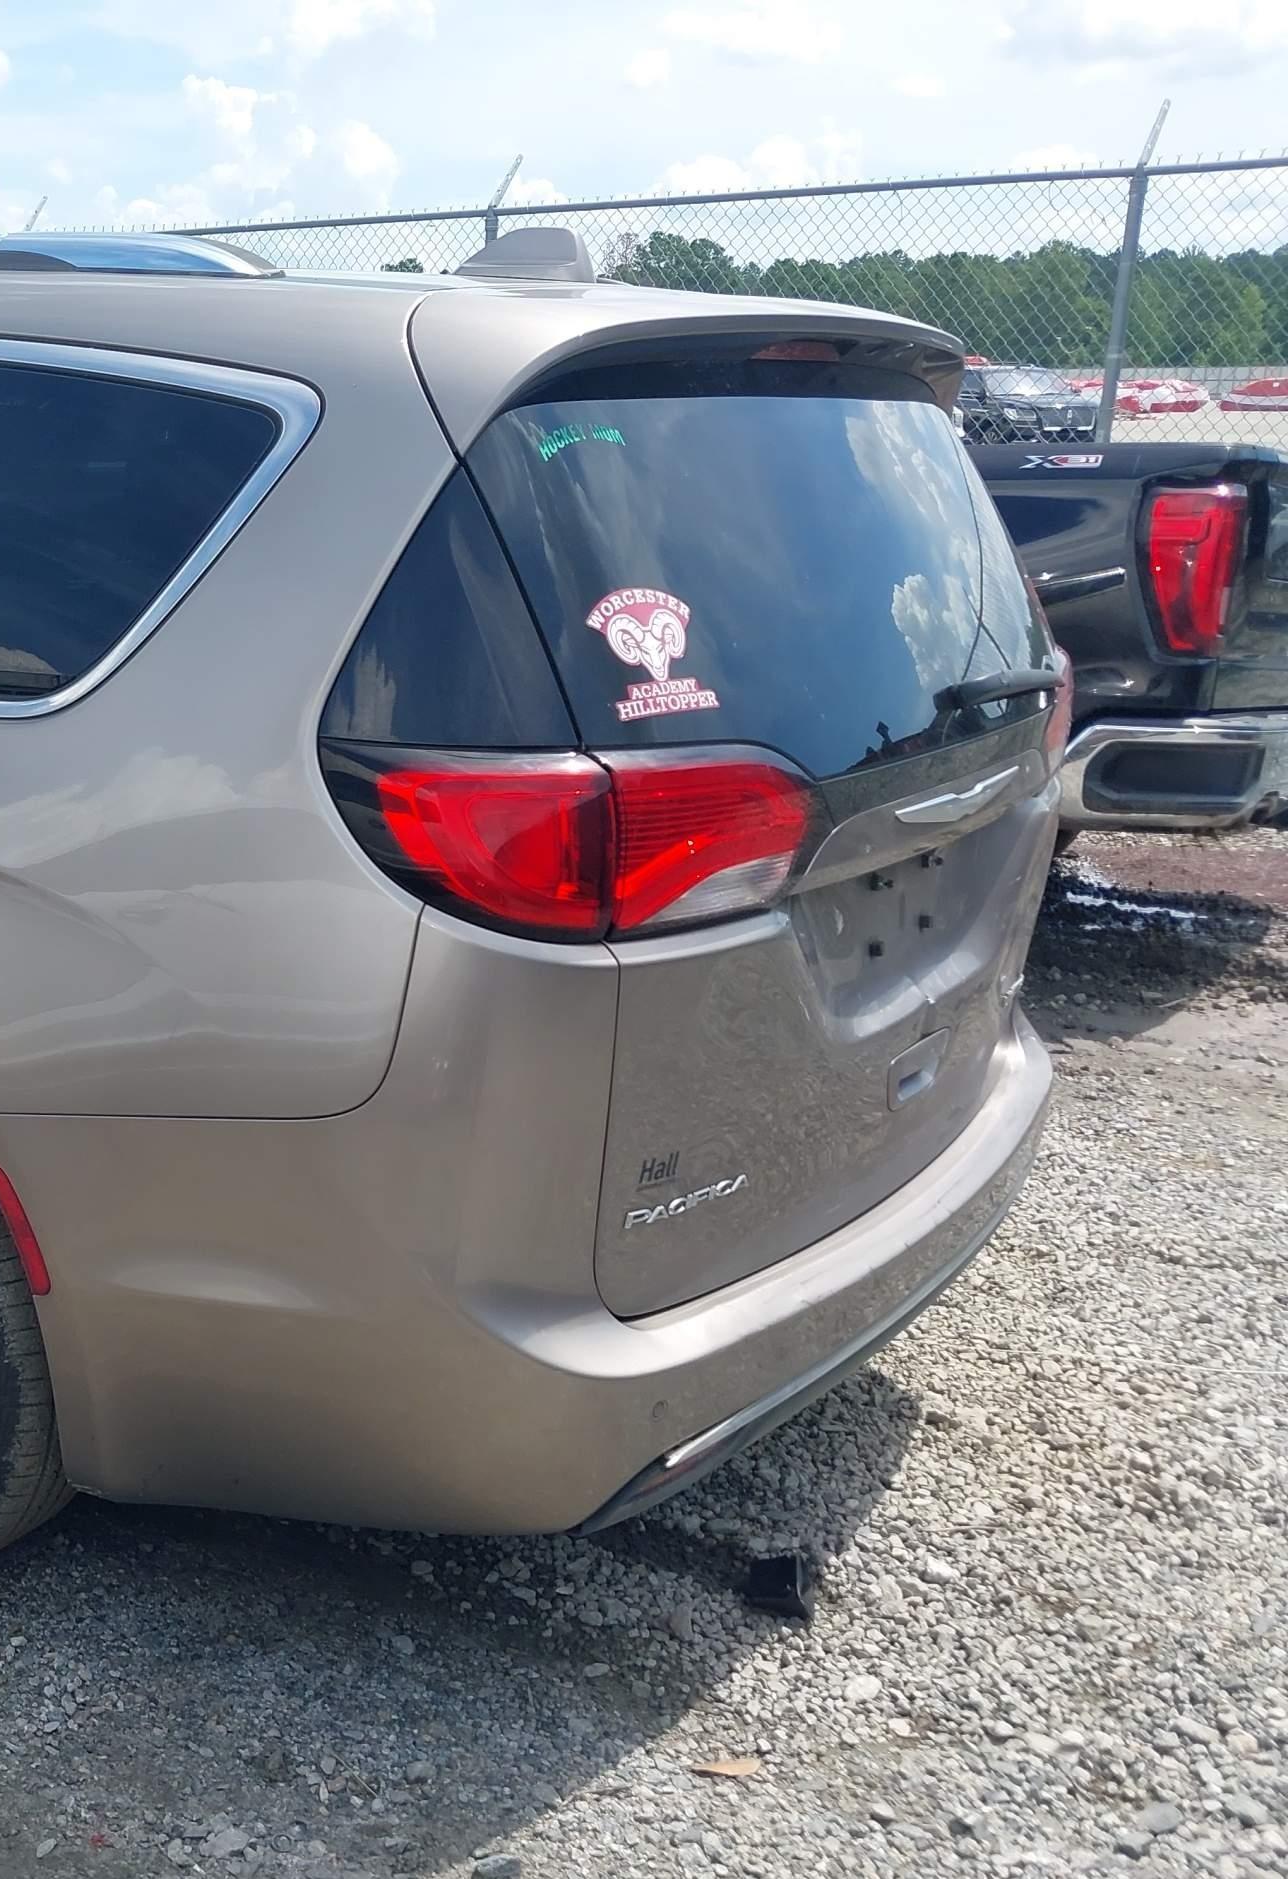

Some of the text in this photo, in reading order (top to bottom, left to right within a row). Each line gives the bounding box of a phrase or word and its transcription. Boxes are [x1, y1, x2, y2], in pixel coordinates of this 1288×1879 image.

[538, 424, 587, 462] HOCKEY
[586, 588, 691, 629] WORCESTER
[616, 690, 720, 719] HILLTOPPER
[631, 678, 698, 700] ACADEMY
[638, 1151, 680, 1184] Hall
[623, 1173, 750, 1230] PACIFICA
